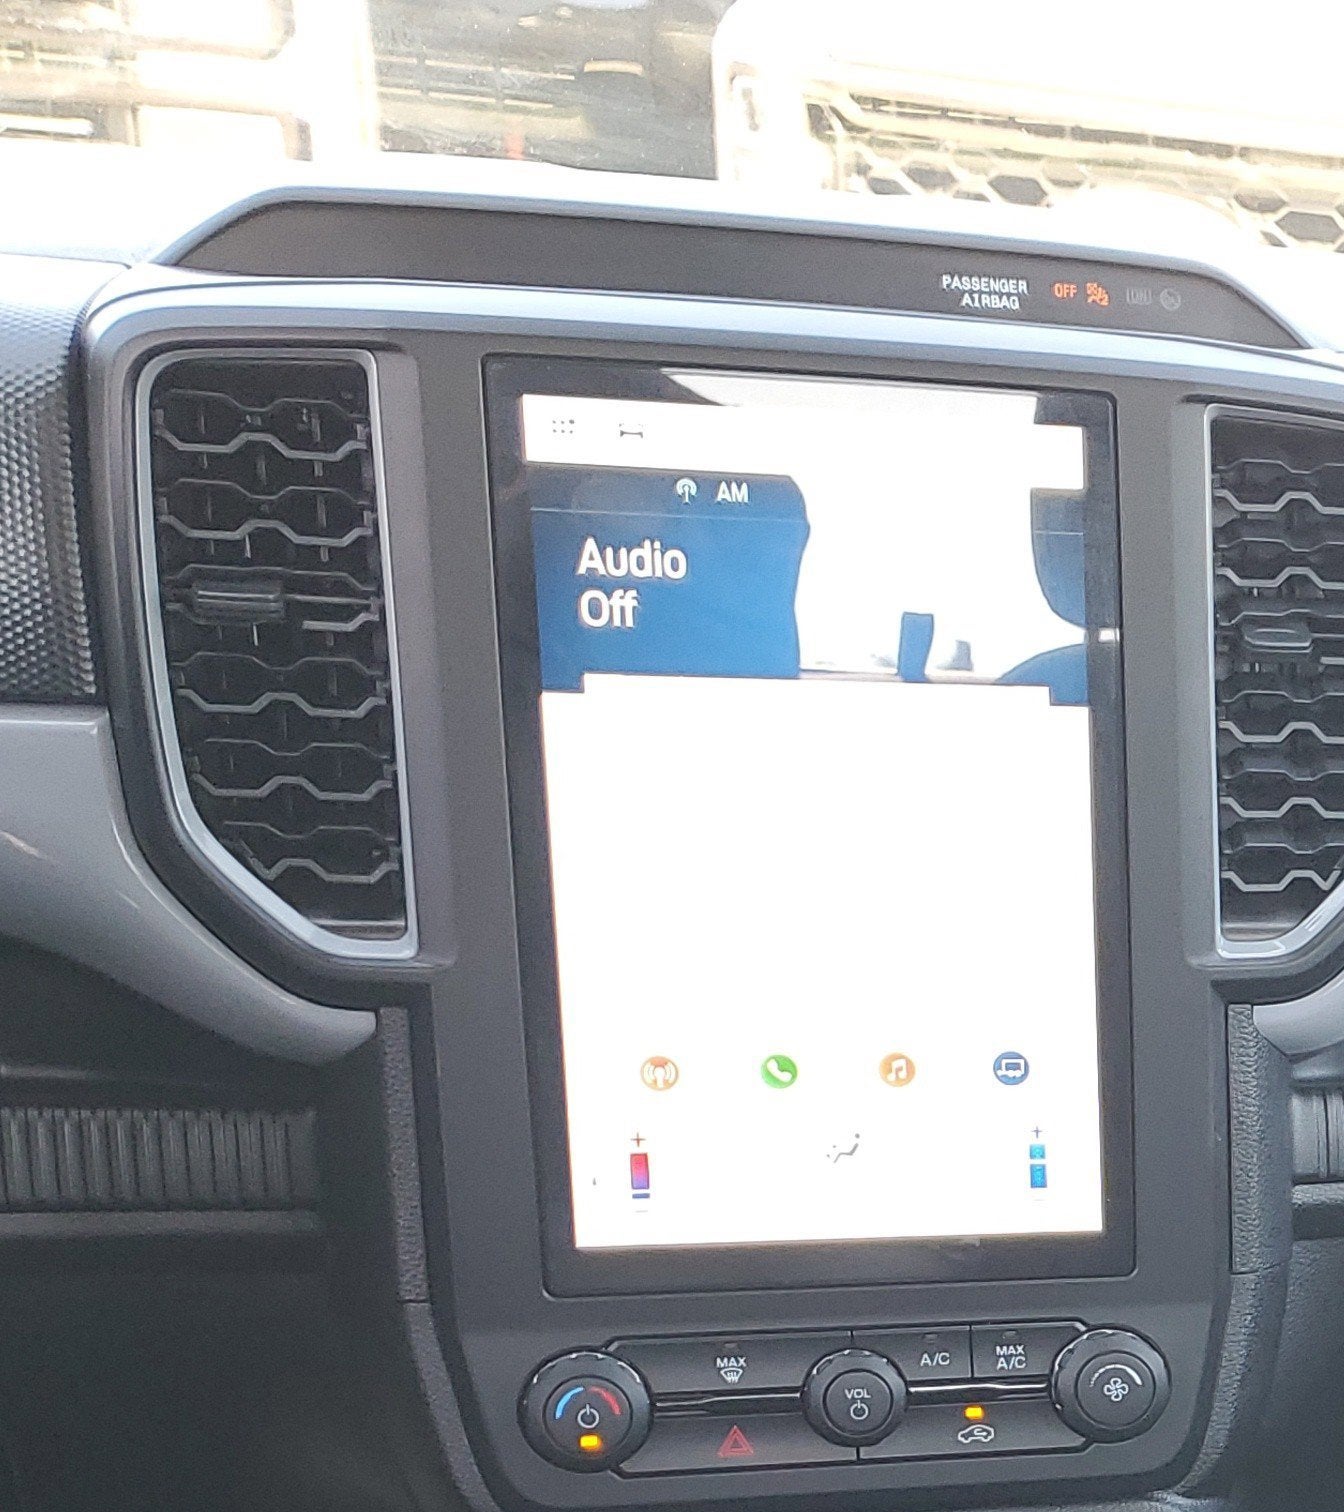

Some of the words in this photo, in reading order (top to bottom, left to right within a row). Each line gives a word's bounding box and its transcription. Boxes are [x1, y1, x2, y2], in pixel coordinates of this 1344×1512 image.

[942, 274, 1028, 295] PASSENGER
[1053, 282, 1078, 299] OFF
[961, 292, 1020, 310] AIRBAG
[716, 481, 749, 504] AM
[576, 538, 687, 580] Audio
[579, 590, 639, 628] Off
[996, 1345, 1025, 1356] MAX
[716, 1356, 747, 1368] MAX
[920, 1352, 950, 1367] A/C
[996, 1356, 1027, 1370] A/C
[845, 1388, 871, 1399] VOL
